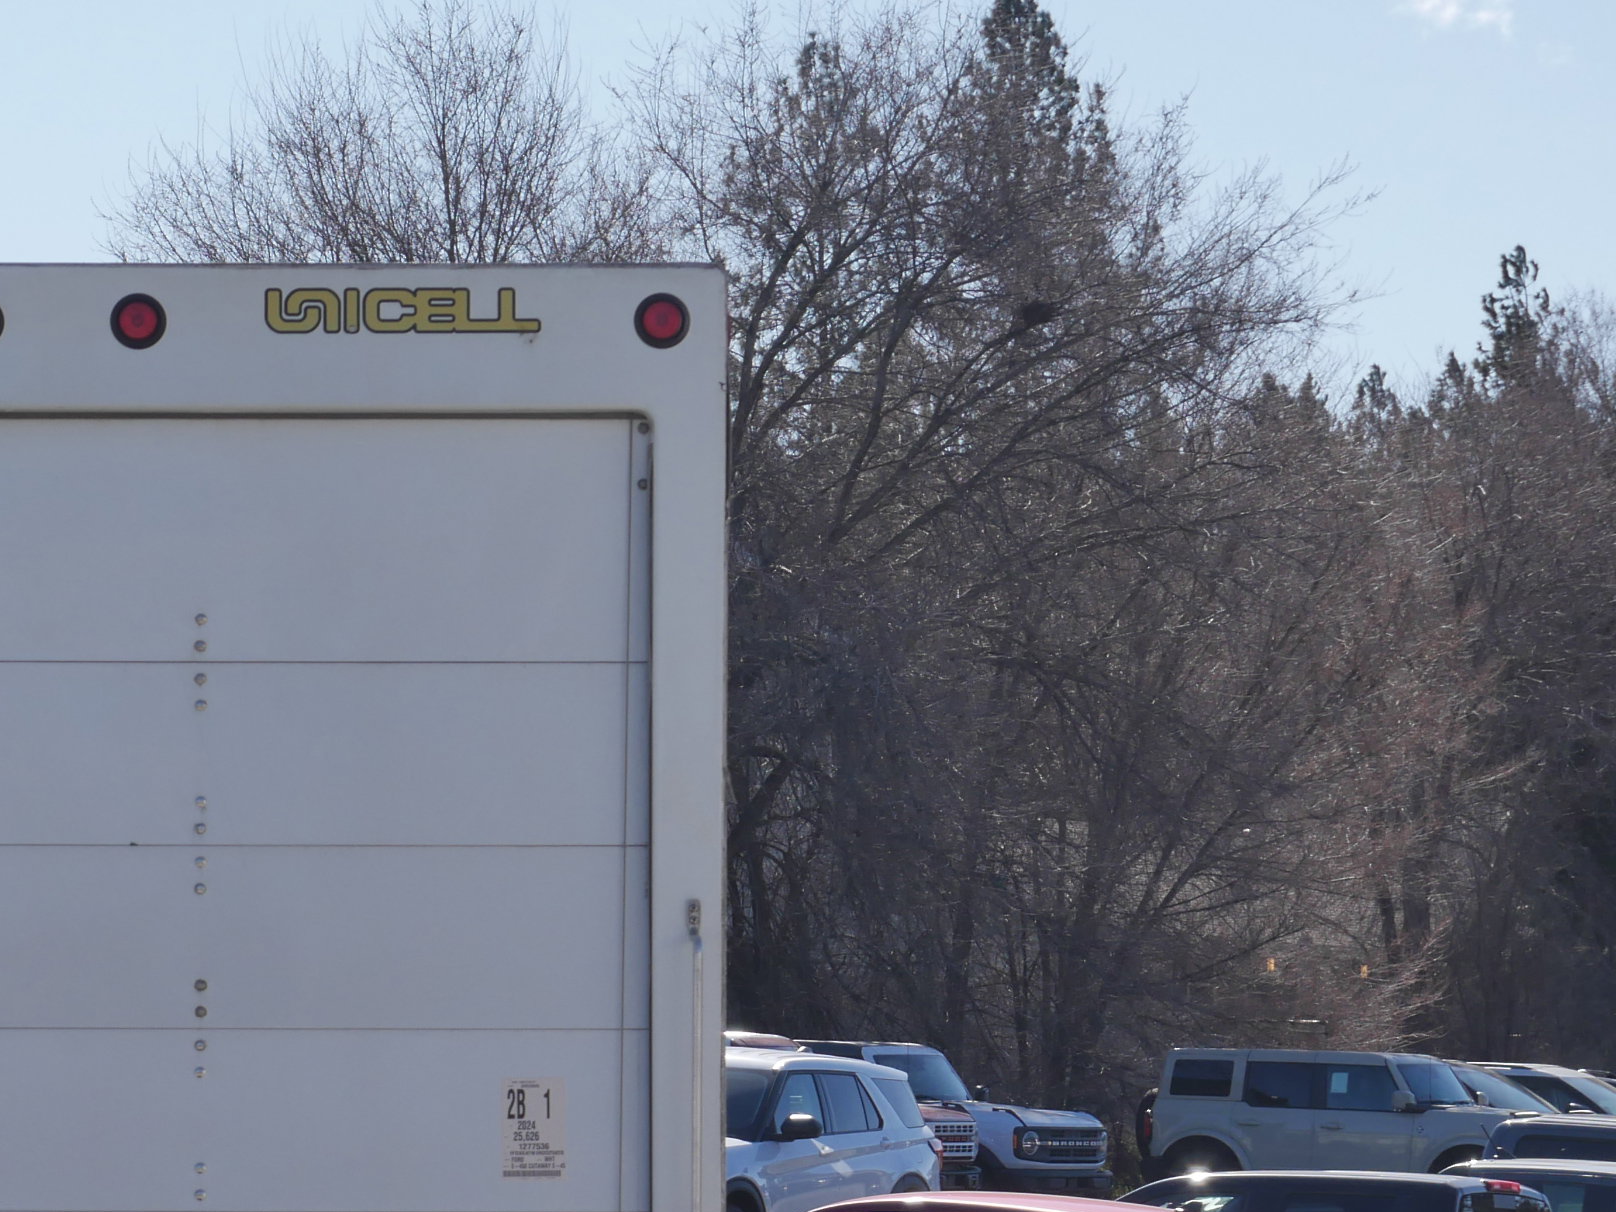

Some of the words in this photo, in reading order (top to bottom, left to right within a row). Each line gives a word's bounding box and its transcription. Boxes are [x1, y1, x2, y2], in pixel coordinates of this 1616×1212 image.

[264, 287, 541, 334] UNICELL
[507, 1088, 526, 1119] 2B
[543, 1088, 550, 1119] 1
[517, 1120, 536, 1130] 2024
